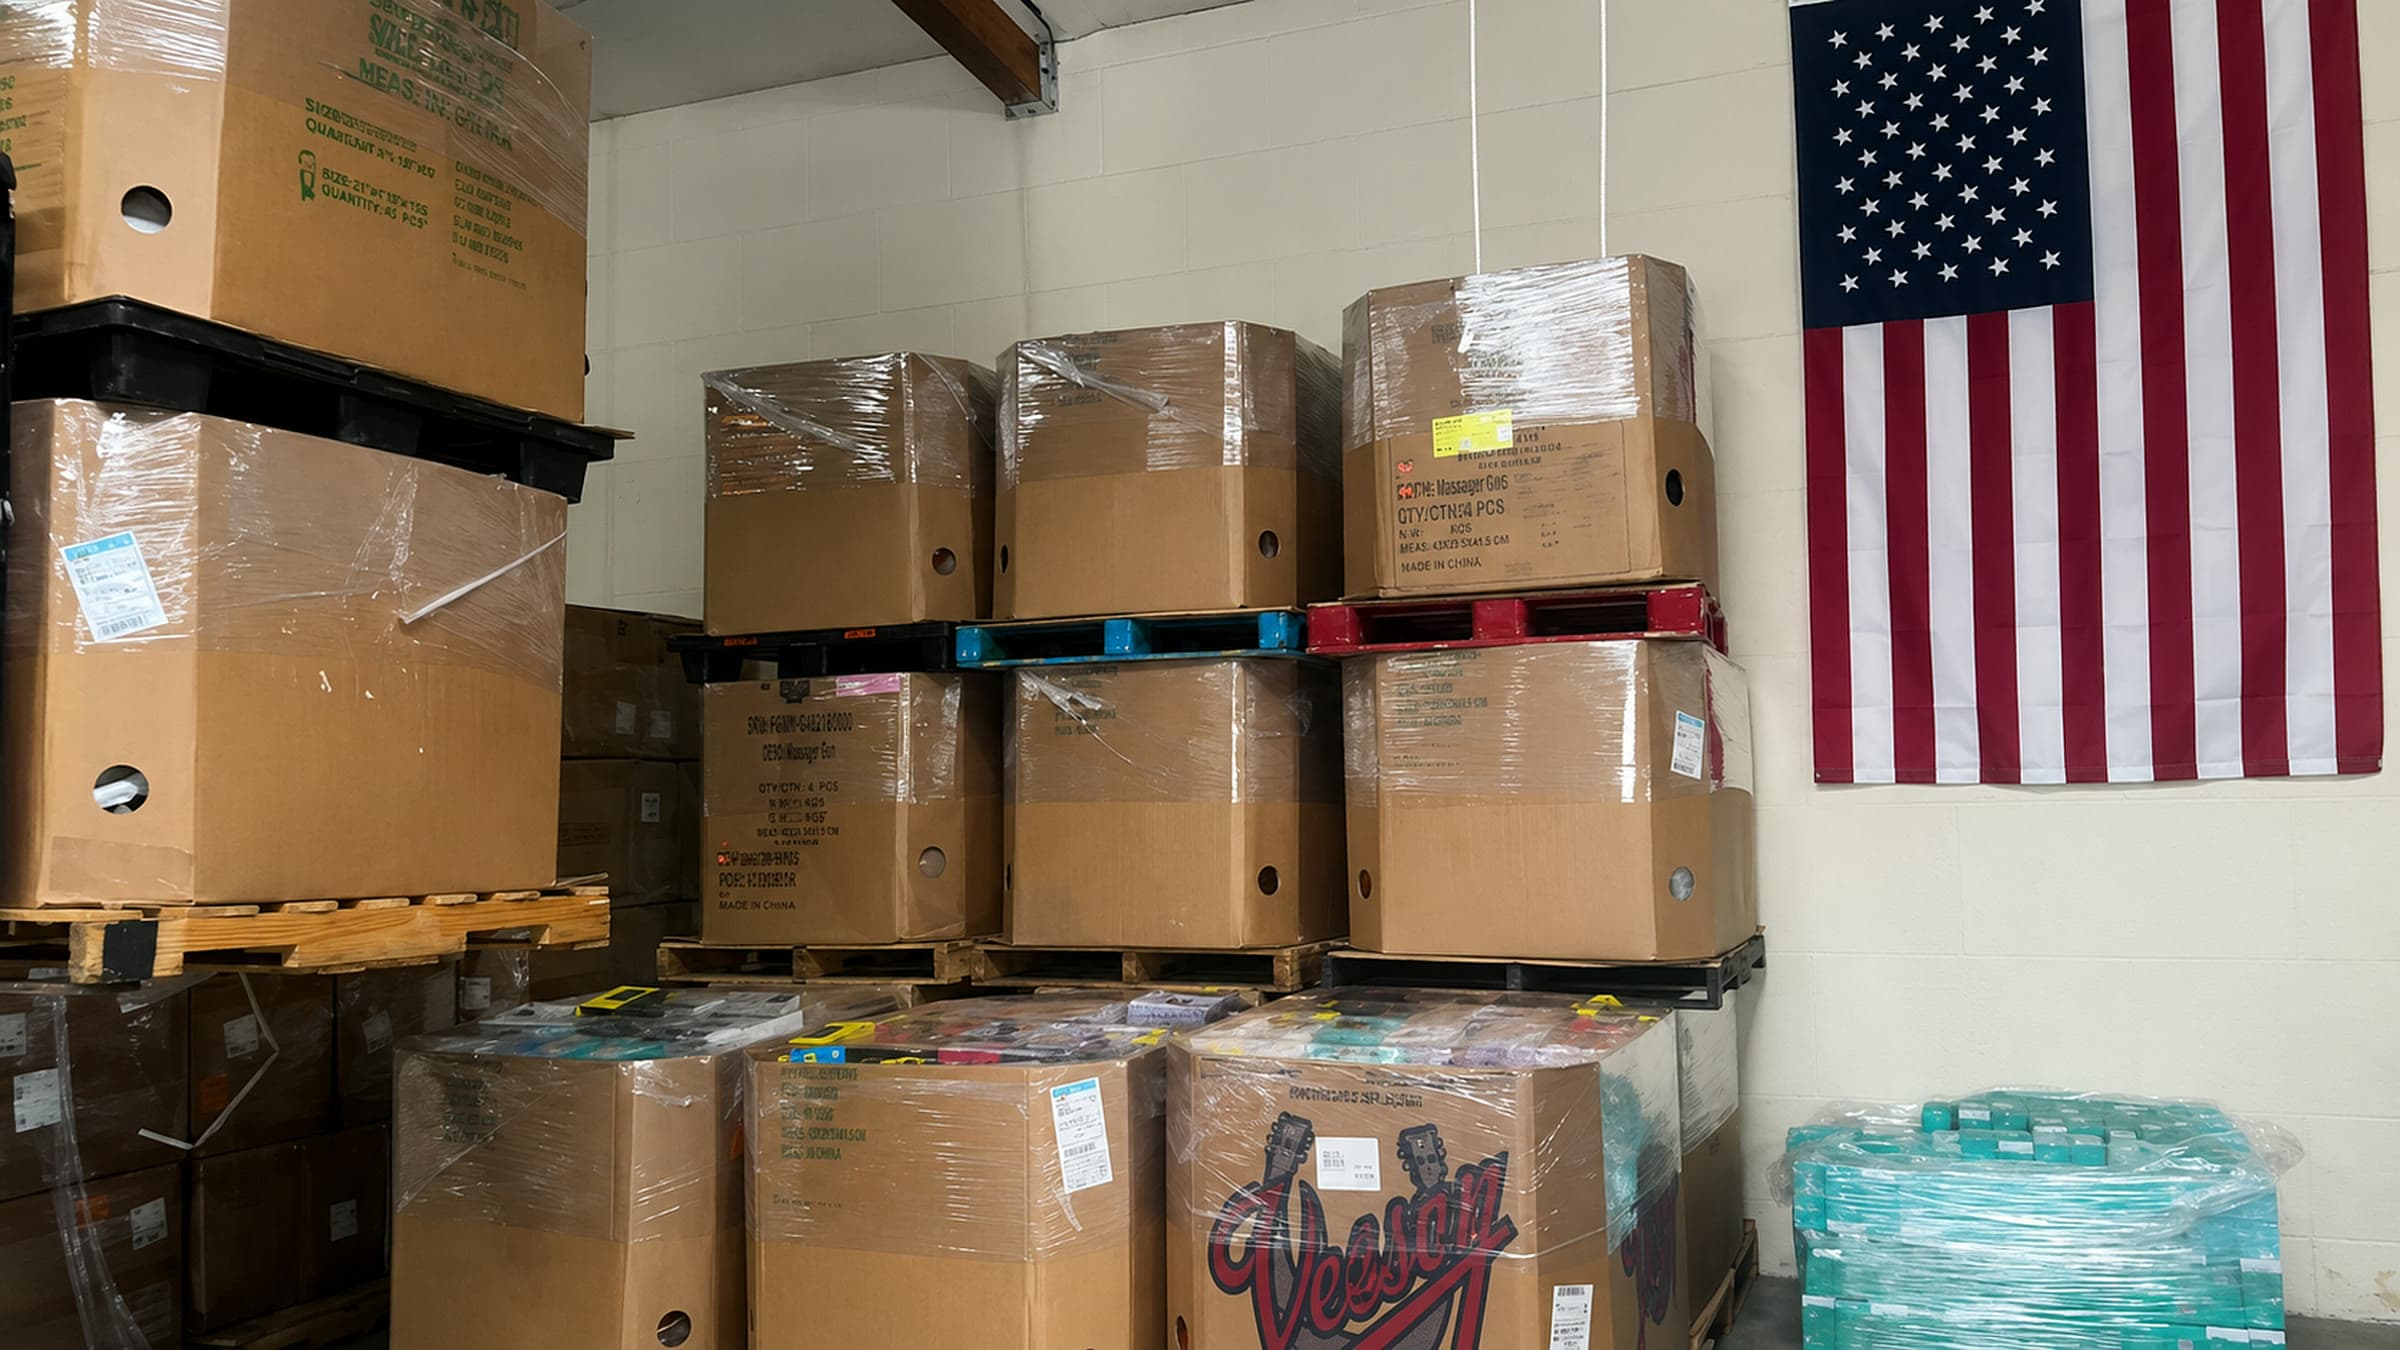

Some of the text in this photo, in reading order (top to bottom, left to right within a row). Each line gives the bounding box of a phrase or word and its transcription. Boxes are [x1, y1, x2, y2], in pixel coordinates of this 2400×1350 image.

[1476, 498, 1505, 517] PCS
[1434, 559, 1445, 569] IN
[1447, 556, 1482, 569] CHINA
